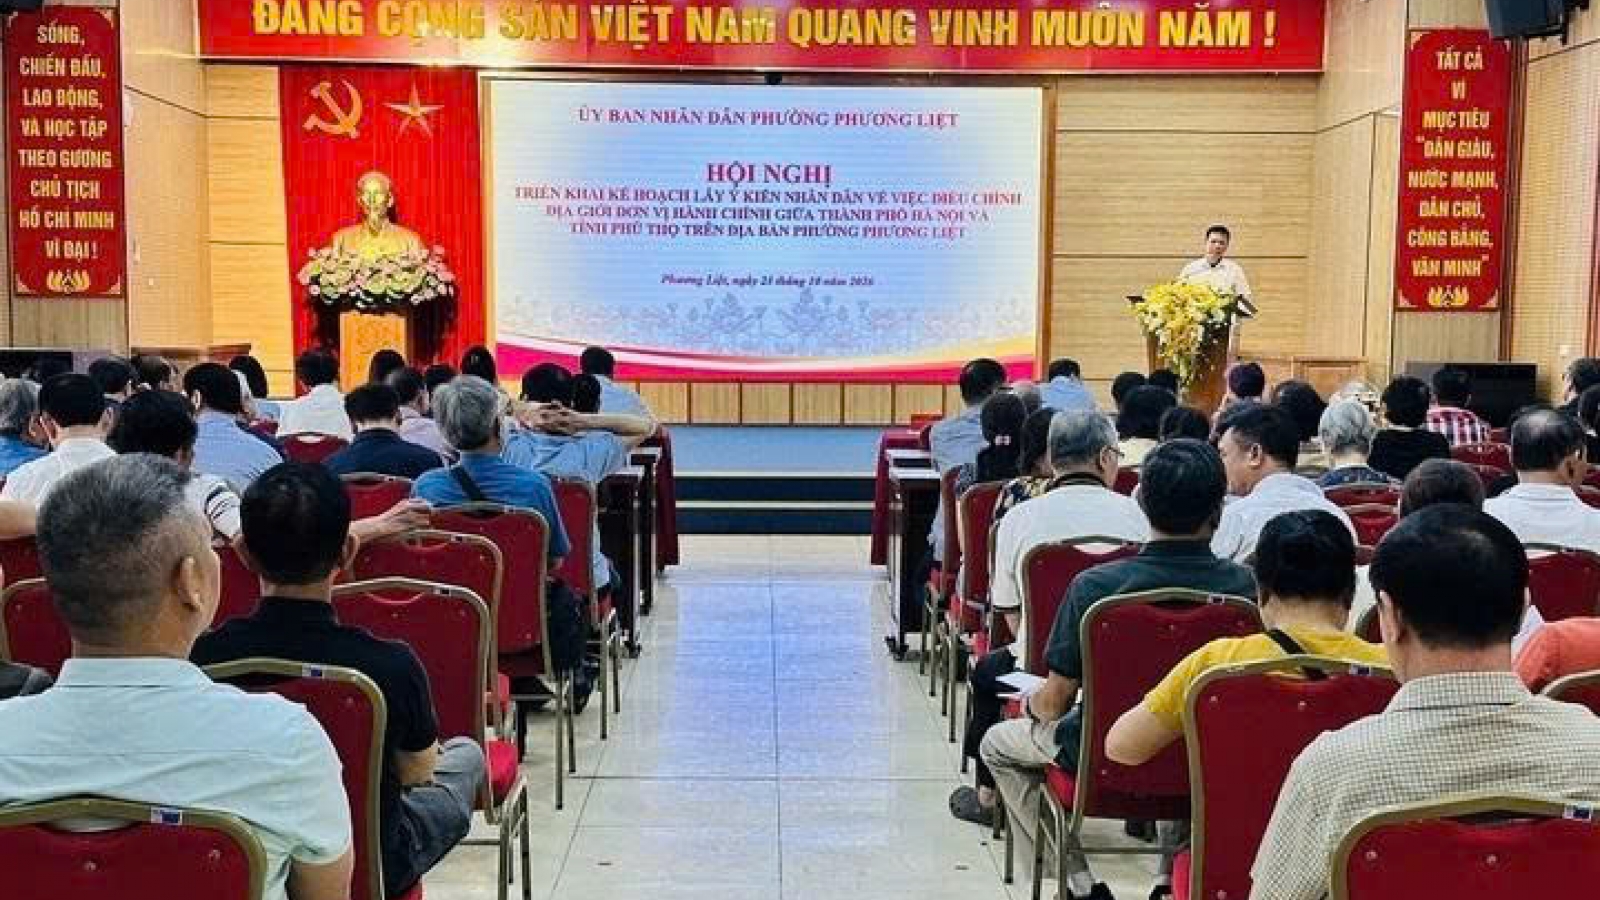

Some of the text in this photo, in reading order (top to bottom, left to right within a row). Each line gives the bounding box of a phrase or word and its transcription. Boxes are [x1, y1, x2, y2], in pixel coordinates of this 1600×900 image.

[37, 20, 85, 46] SỐNG,
[590, 0, 674, 49] VIỆT
[686, 6, 776, 43] NAM
[788, 8, 916, 47] QUANG
[929, 9, 1018, 45] VINH
[1031, 2, 1144, 46] MUÔN
[1159, 2, 1250, 46] NĂM
[19, 51, 65, 76] CHIẾN
[1437, 45, 1484, 70] TẤT CẢ
[23, 89, 51, 107] LAO
[21, 116, 107, 141] VÀ HỌC TẬP
[608, 108, 645, 123] BAN
[650, 108, 702, 124] NHÂN
[708, 107, 747, 125] DÂN
[750, 109, 829, 126] PHƯỜNG
[835, 110, 912, 127] PHƯƠNG
[917, 109, 959, 130] LIỆT
[1422, 107, 1490, 132] MỤC TIÊU
[18, 148, 112, 168] THEO GƯƠNG
[707, 161, 832, 187] HỘI NGHỊ
[1408, 168, 1448, 188] NƯỚC
[30, 173, 100, 203] CHỦ TỊCH
[566, 186, 604, 200] KHAI
[635, 187, 690, 205] HOẠCH
[785, 188, 827, 203] NHÂN
[832, 188, 863, 203] DÂN
[891, 190, 929, 207] VIỆC
[44, 207, 70, 229] CHÍ
[73, 211, 114, 230] MINH
[673, 205, 716, 219] HÀNH
[722, 206, 771, 220] CHÍNH
[682, 221, 724, 236] TRÊN
[1408, 226, 1447, 247] CÔNG
